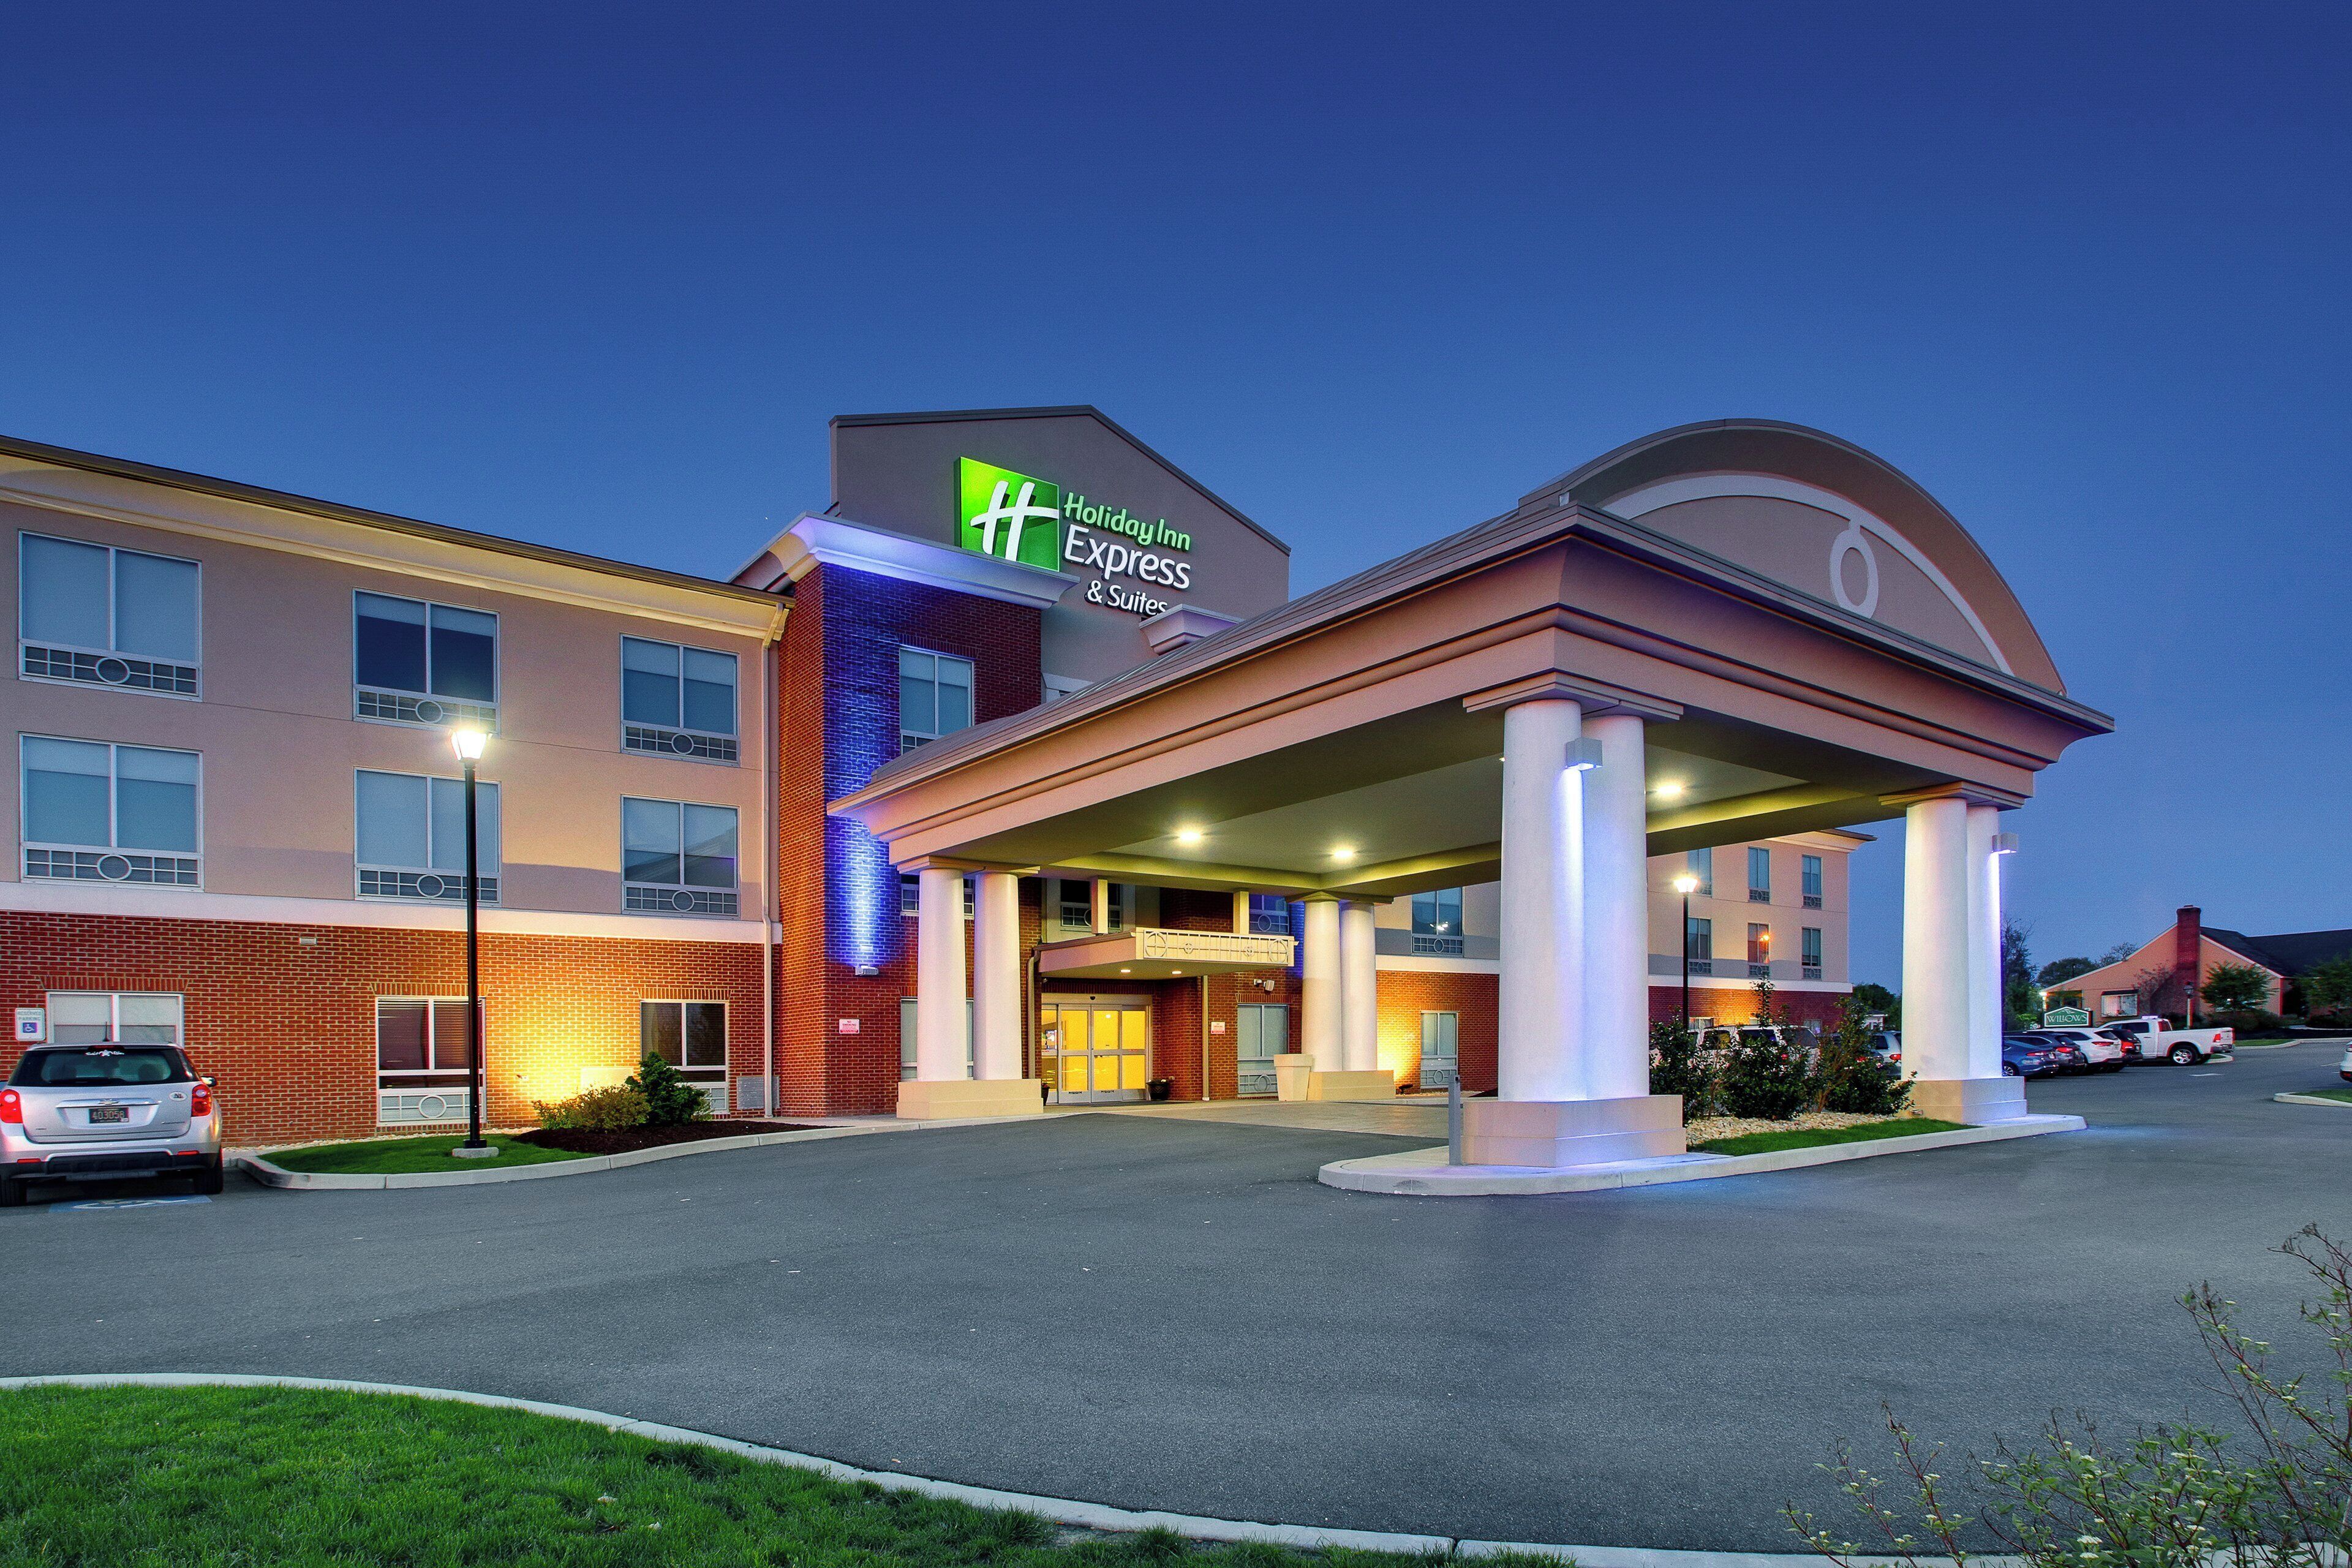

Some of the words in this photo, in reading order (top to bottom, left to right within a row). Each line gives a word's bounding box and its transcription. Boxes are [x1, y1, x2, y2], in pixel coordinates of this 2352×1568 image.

[1064, 492, 1154, 545] Holiday
[1156, 519, 1190, 551] Inn
[1065, 524, 1191, 589] Express
[1087, 580, 1102, 603] &
[1107, 585, 1167, 615] Suites
